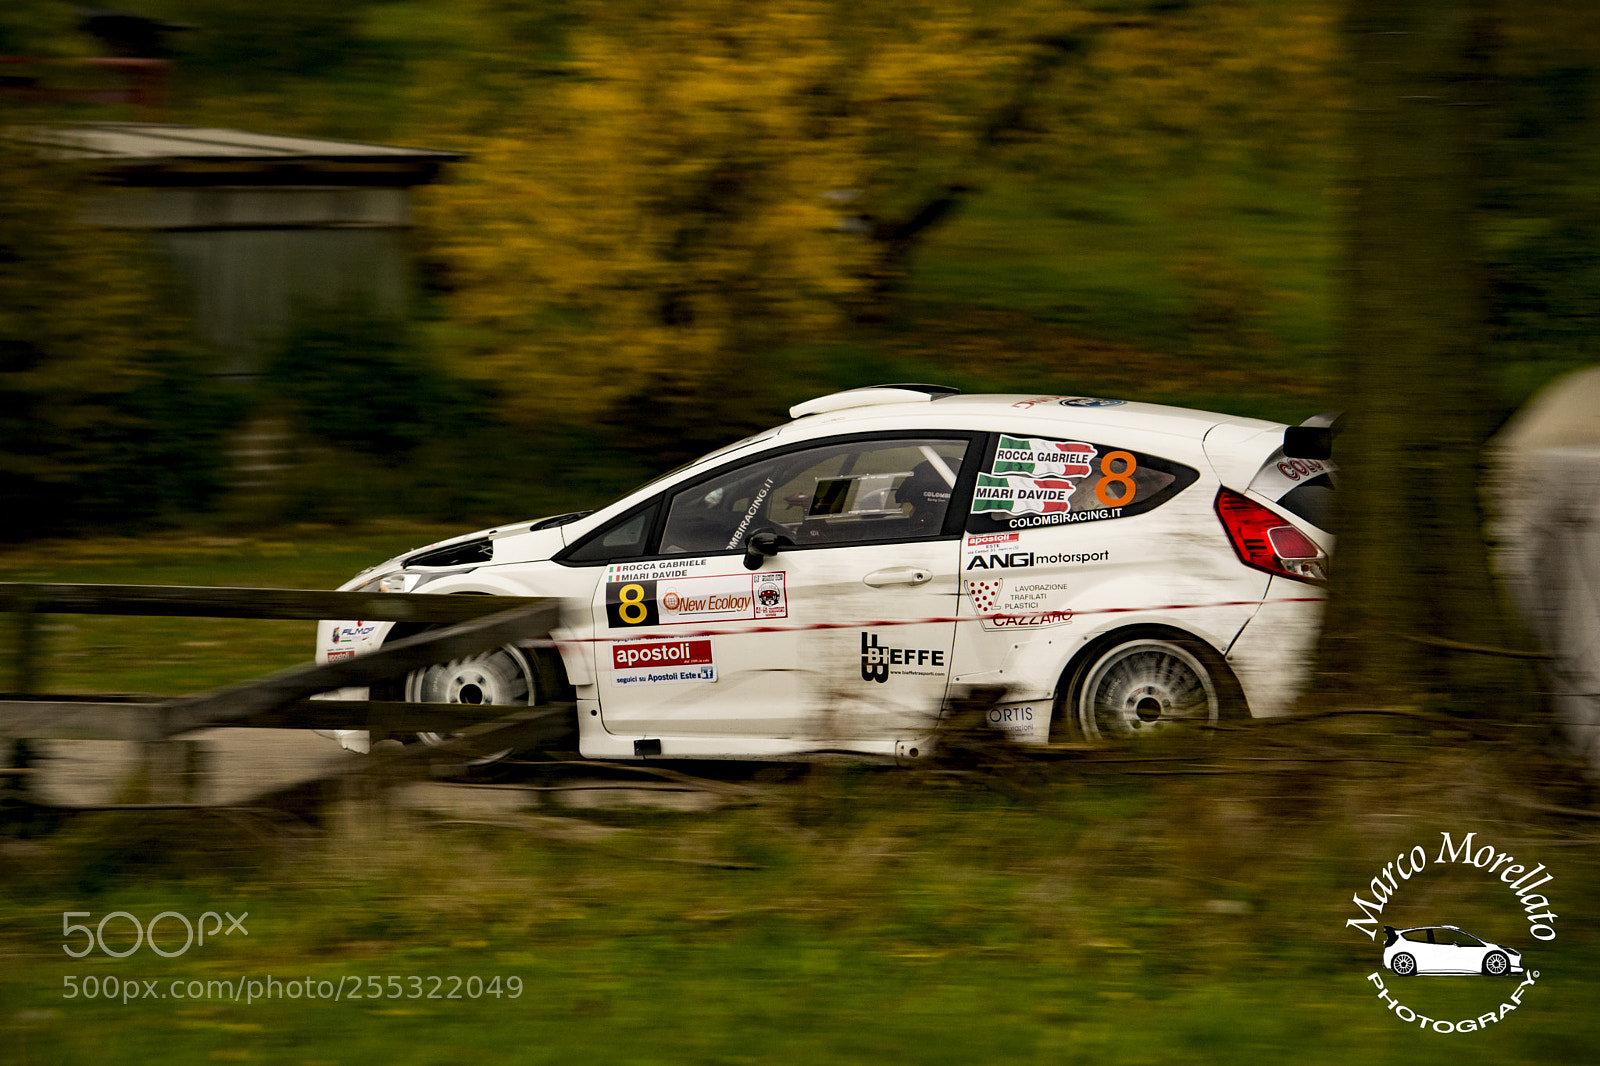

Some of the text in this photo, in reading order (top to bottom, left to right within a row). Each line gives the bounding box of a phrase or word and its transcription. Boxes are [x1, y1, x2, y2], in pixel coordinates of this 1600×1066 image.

[997, 450, 1089, 464] ROCCA GABRIELE
[1095, 450, 1137, 508] 8
[975, 488, 1066, 500] MIARI DAVIDE
[1009, 507, 1123, 529] COLOMBIRACING.IT
[969, 534, 1009, 545] apostoli
[622, 559, 707, 572] ROCCA GABRIELE
[966, 550, 1110, 570] ANGI motorsport
[621, 570, 688, 581] MIARI DAVIDE
[1014, 583, 1068, 592] LAVORAZIONE
[618, 583, 648, 624] 8
[679, 597, 707, 612] New
[708, 594, 752, 612] Ecology
[1010, 593, 1047, 601] TRAFILATI
[1004, 602, 1039, 610] PLASTICI
[616, 643, 691, 666] apostoli
[616, 675, 638, 684] seguici
[647, 672, 678, 683] Apostoli
[680, 671, 697, 679] Este
[989, 706, 1033, 723] ORTIS
